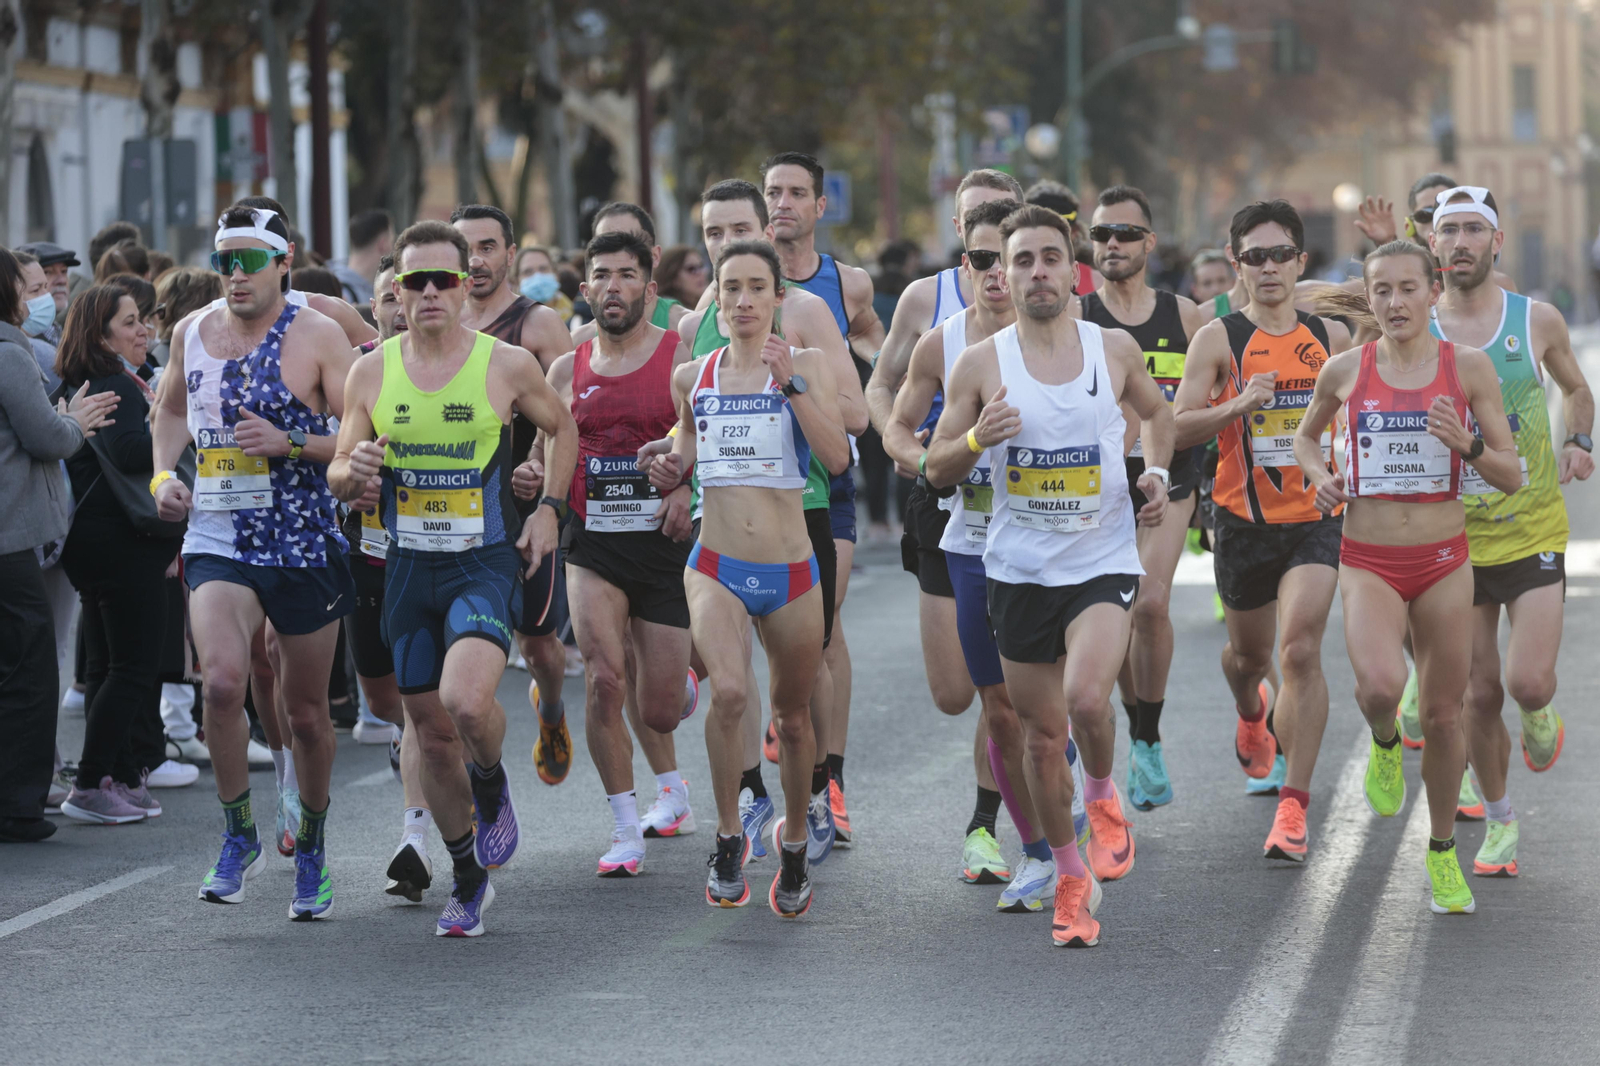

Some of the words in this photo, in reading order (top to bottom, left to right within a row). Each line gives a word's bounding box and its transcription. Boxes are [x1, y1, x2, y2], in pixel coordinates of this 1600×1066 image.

[722, 398, 771, 411] ZURICH
[1278, 394, 1314, 406] ZURIC
[1387, 416, 1429, 428] ZURIC
[722, 425, 751, 438] F237
[212, 432, 239, 445] ZUR
[718, 446, 756, 457] SUSANA
[1388, 442, 1419, 455] F244
[1036, 451, 1089, 465] ZURICH
[216, 459, 235, 471] 478
[603, 461, 638, 472] ZURIC
[1383, 463, 1425, 474] SUSANA
[220, 480, 232, 490] GG
[418, 473, 470, 486] ZURICH
[605, 484, 634, 497] 2540
[1041, 480, 1065, 492] 444
[424, 500, 447, 513] 483
[601, 503, 642, 513] DOMINGO
[1028, 499, 1081, 511] GONZÁLEZ
[423, 521, 451, 531] DAVID
